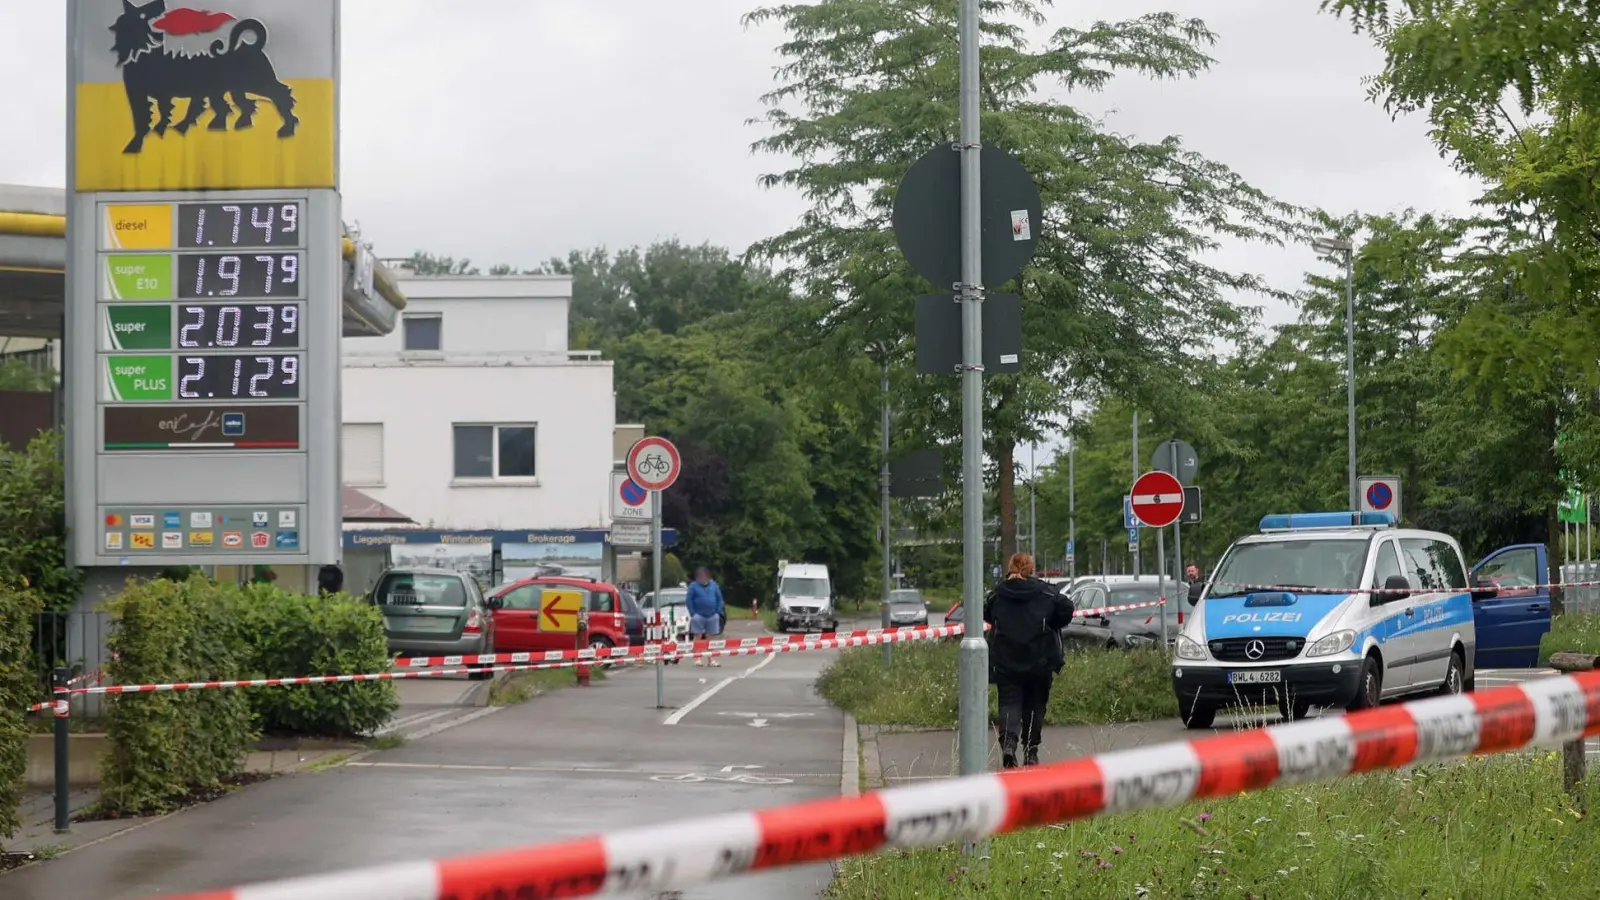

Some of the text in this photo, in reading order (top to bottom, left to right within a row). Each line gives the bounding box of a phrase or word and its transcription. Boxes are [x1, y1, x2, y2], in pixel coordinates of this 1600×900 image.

[115, 219, 147, 231] diesel
[195, 204, 298, 246] 1.749
[114, 264, 146, 275] super
[195, 255, 298, 296] 1.979
[136, 278, 159, 290] E10
[114, 321, 147, 333] super
[179, 305, 298, 347] 2.039
[114, 364, 147, 376] super
[179, 356, 298, 398] 2.129
[133, 379, 167, 391] PLUS
[622, 507, 645, 517] ZONE
[134, 516, 151, 524] VISA
[352, 534, 407, 546] Liegeplätze
[439, 534, 494, 544] Winterlager
[527, 533, 576, 544] Brokerage
[1222, 611, 1303, 625] POLIZEI
[1259, 671, 1280, 682] 6282
